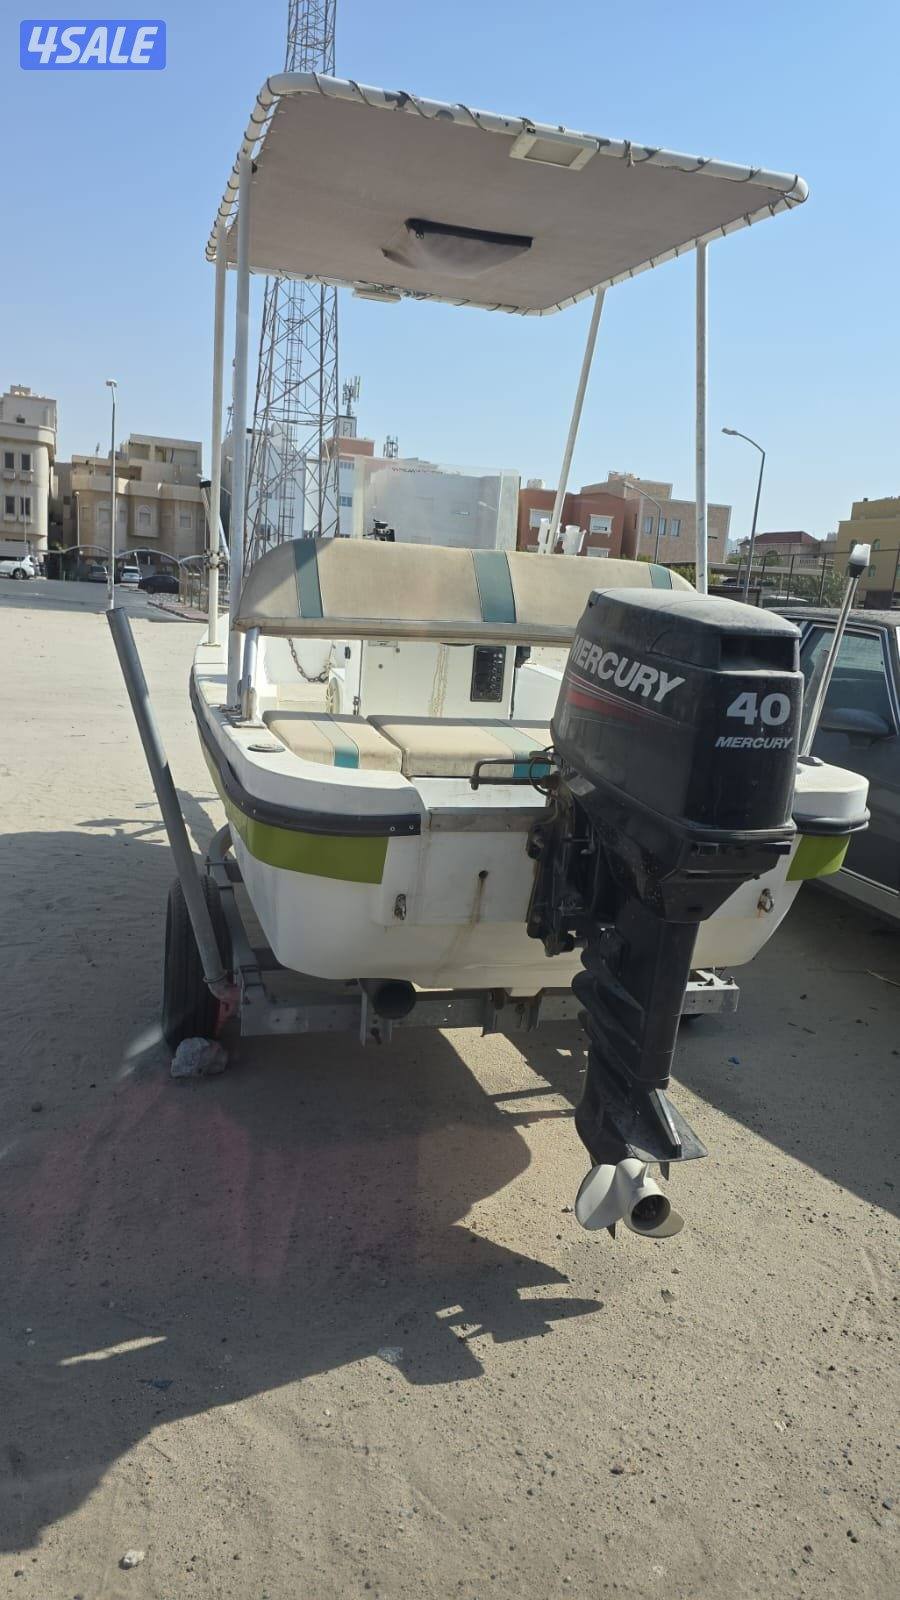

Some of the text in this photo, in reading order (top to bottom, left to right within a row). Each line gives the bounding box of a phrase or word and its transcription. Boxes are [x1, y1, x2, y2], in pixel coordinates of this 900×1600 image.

[570, 636, 686, 703] MERCURY
[726, 692, 791, 726] 40
[714, 736, 793, 749] MERCURY
